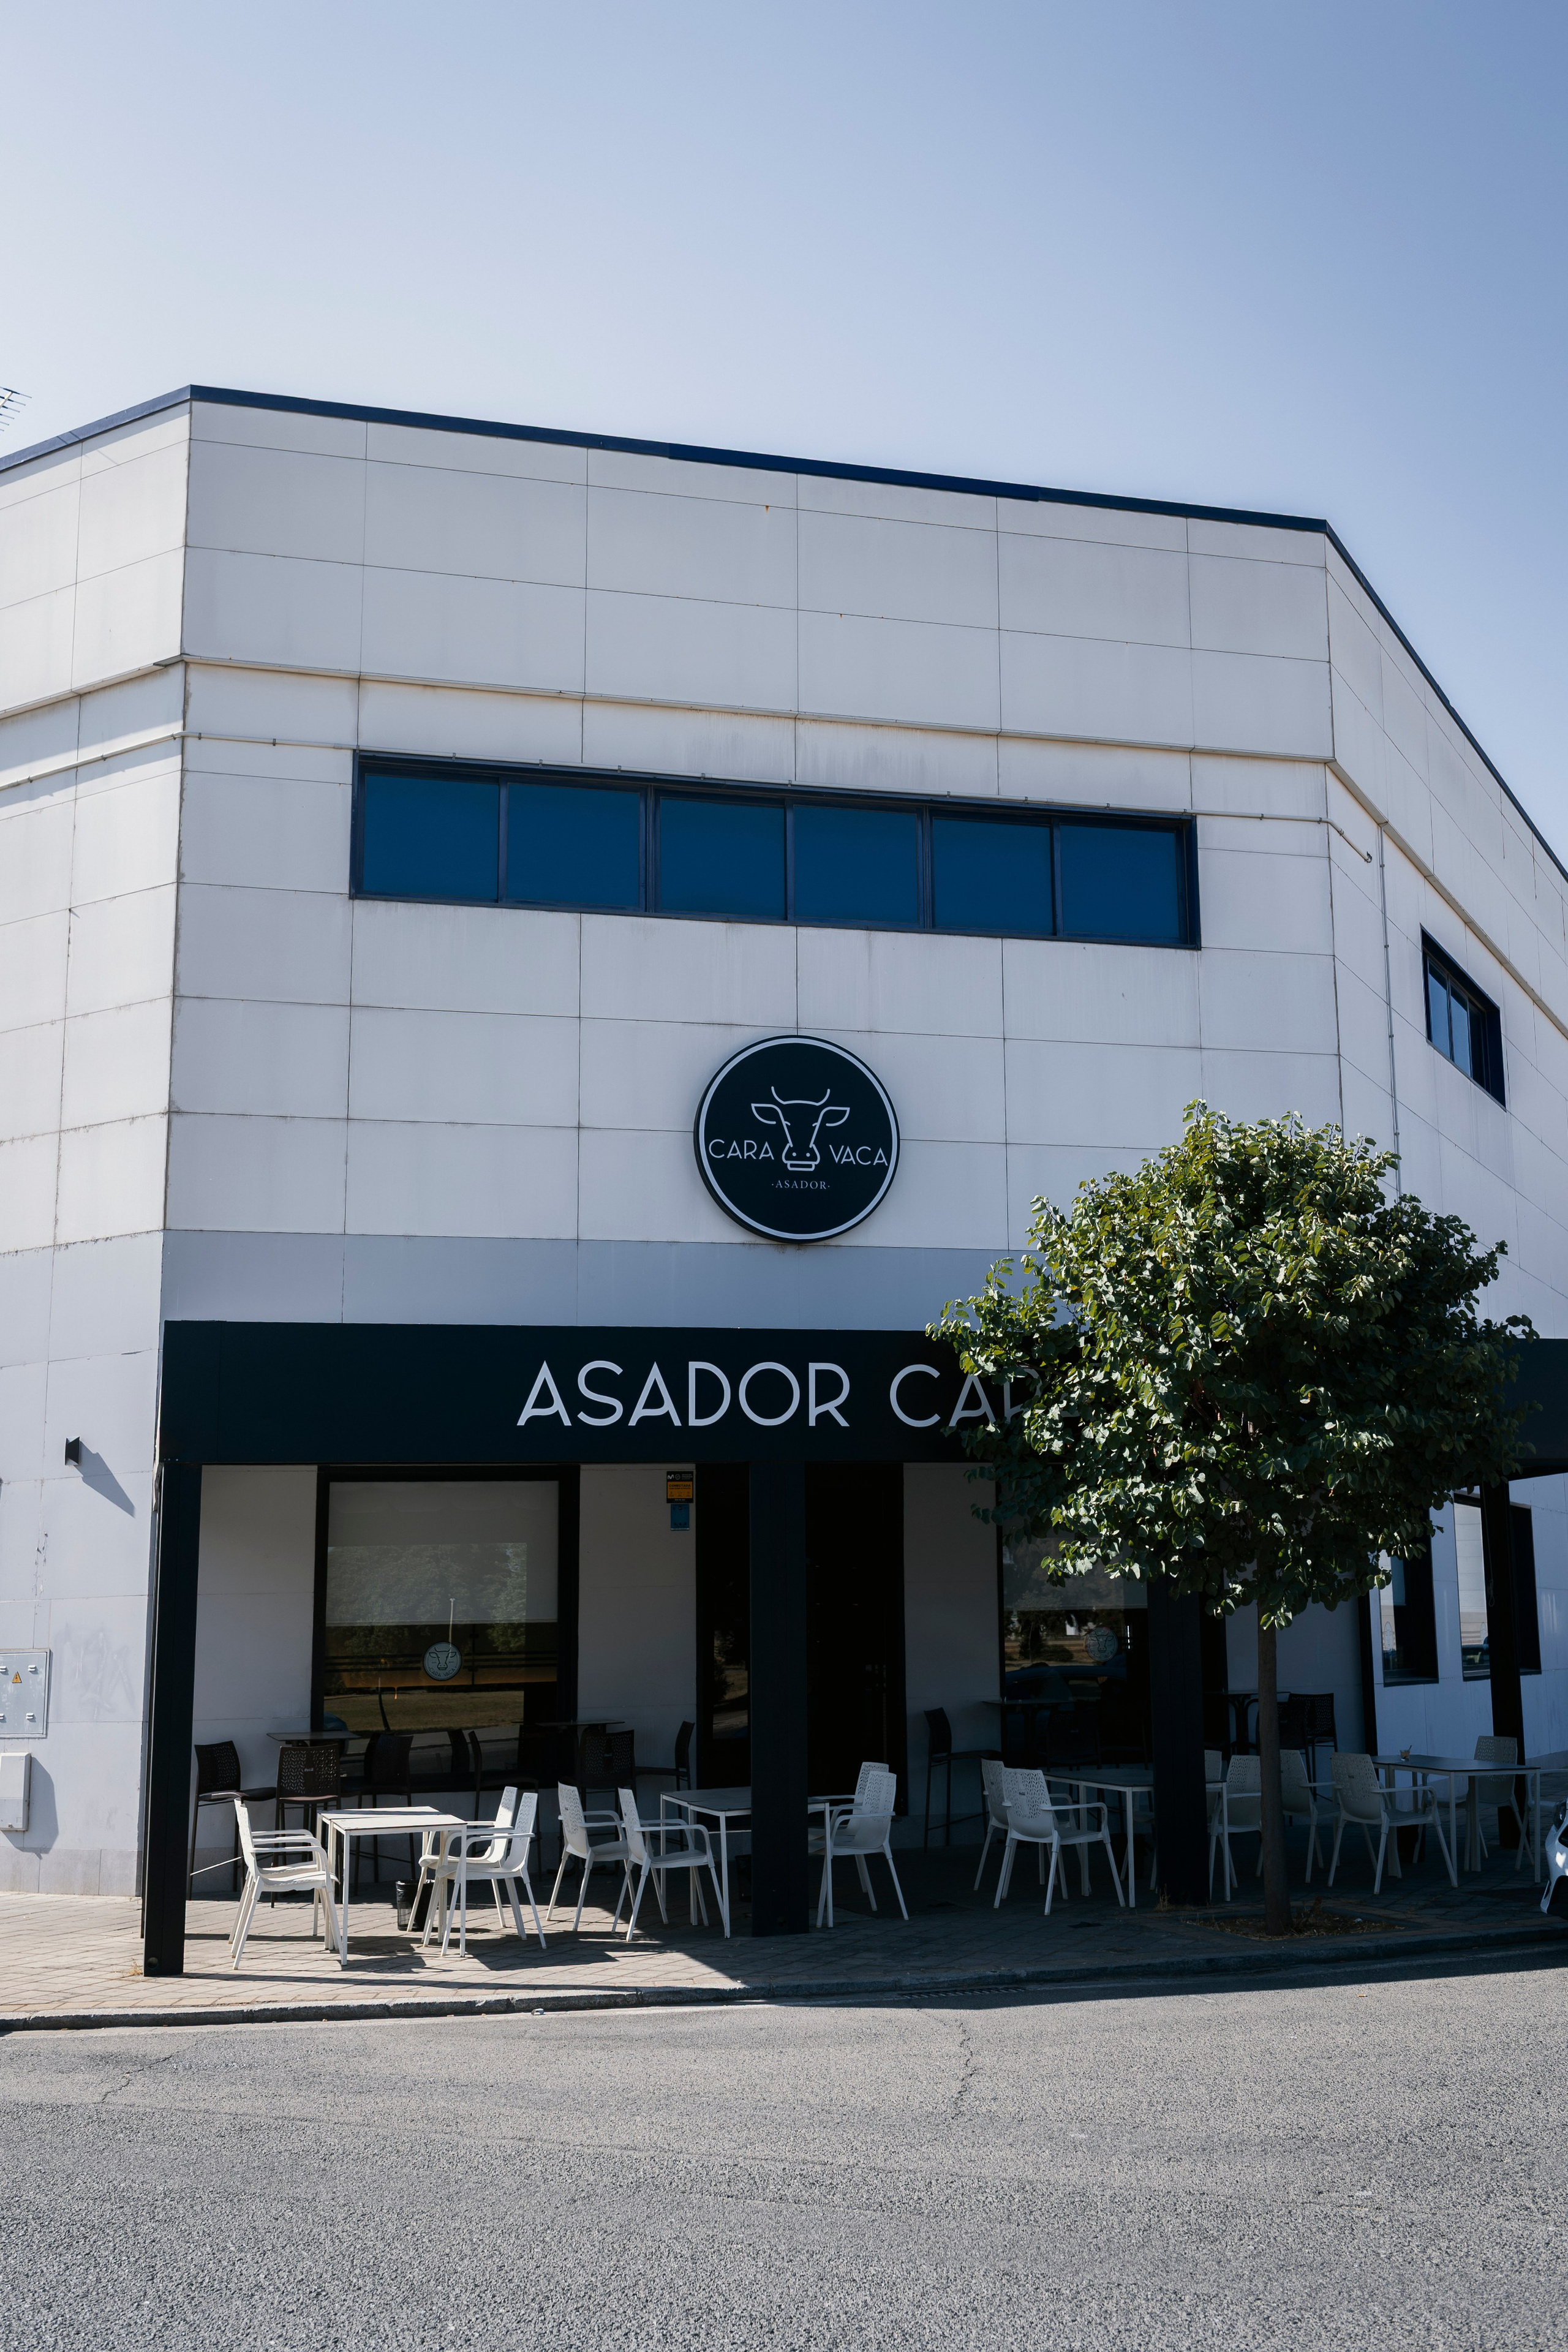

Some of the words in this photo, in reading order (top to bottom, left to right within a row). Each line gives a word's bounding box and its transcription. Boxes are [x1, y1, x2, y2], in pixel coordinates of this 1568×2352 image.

[709, 1139, 775, 1160] CARA
[829, 1144, 888, 1166] VACA
[516, 1360, 850, 1427] ASADOR
[429, 1667, 441, 1677] CARA
[443, 1668, 456, 1677] VACA
